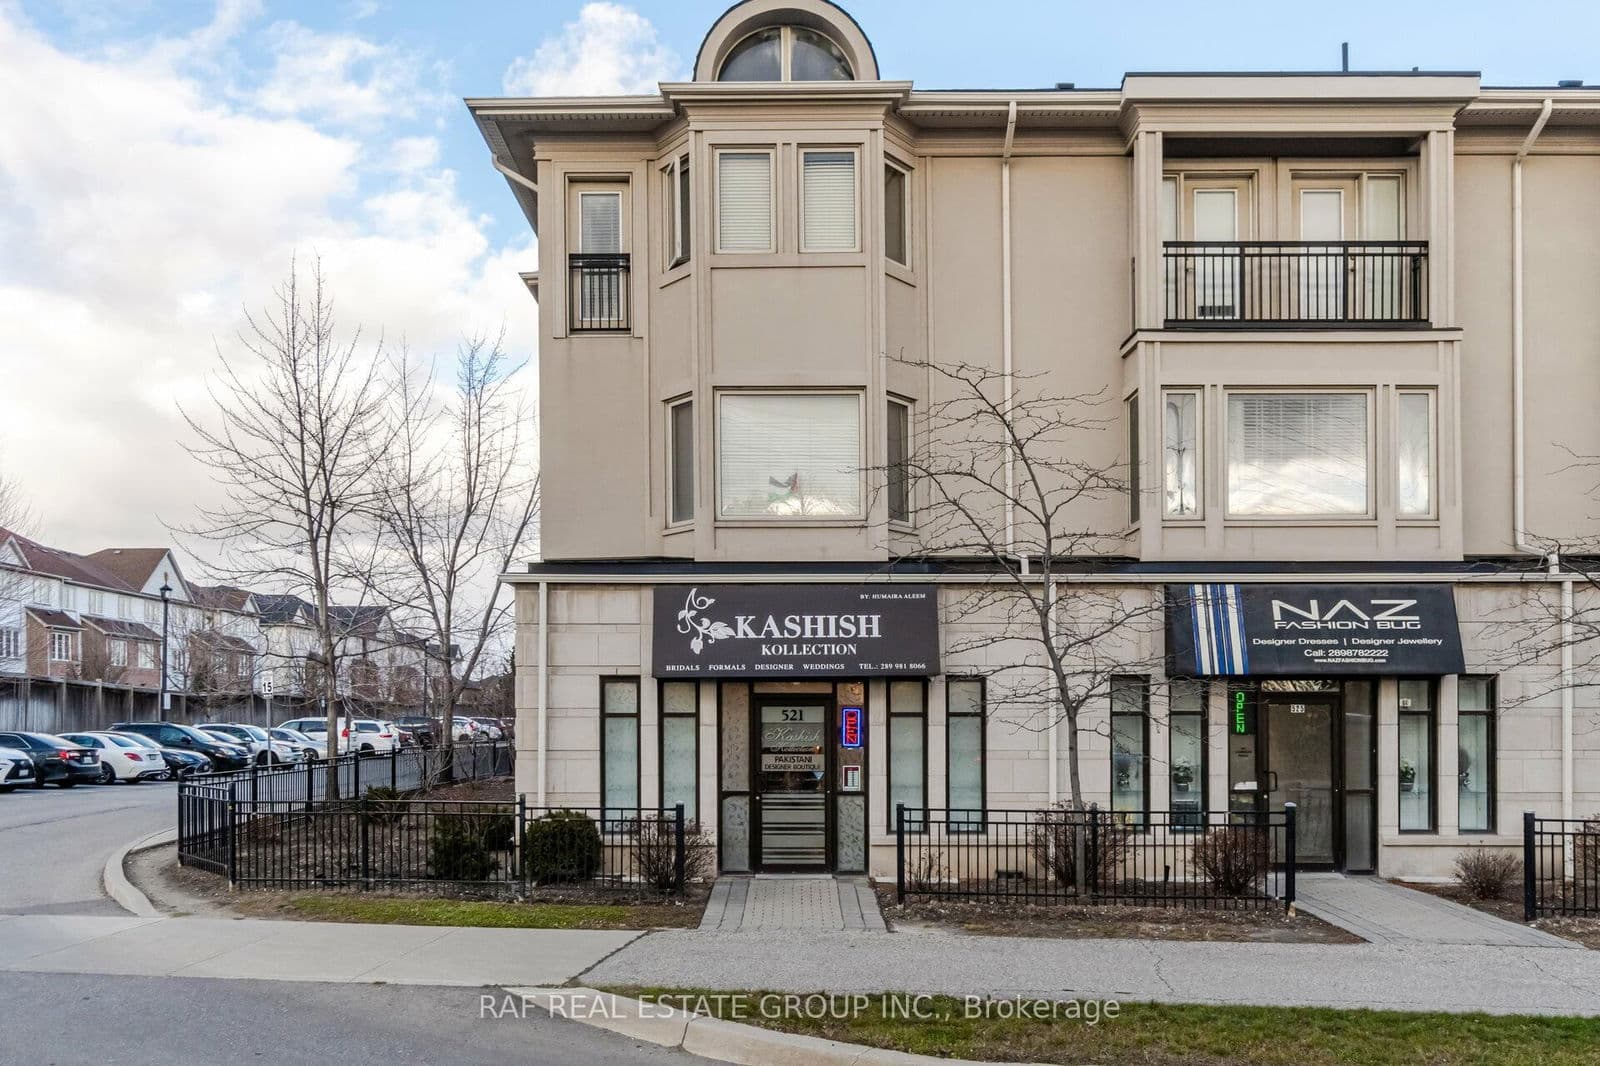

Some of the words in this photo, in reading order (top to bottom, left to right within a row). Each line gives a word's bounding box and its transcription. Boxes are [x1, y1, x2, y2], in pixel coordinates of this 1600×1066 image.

[1271, 599, 1420, 620] NAZ
[734, 614, 882, 639] KASHISH
[1274, 621, 1369, 630] FASHION
[1376, 621, 1422, 630] BUG
[1252, 638, 1297, 646] Designer
[1298, 637, 1339, 645] Dresses
[1351, 637, 1396, 646] Designer
[1397, 637, 1443, 646] Jewellery
[761, 643, 857, 656] KOLLECTION
[1304, 649, 1327, 657] Call:
[1327, 649, 1389, 657] 2898782222
[665, 664, 701, 672] BRIDALS
[754, 663, 794, 671] DESIGNER
[263, 682, 273, 693] 15
[781, 709, 804, 721] 521
